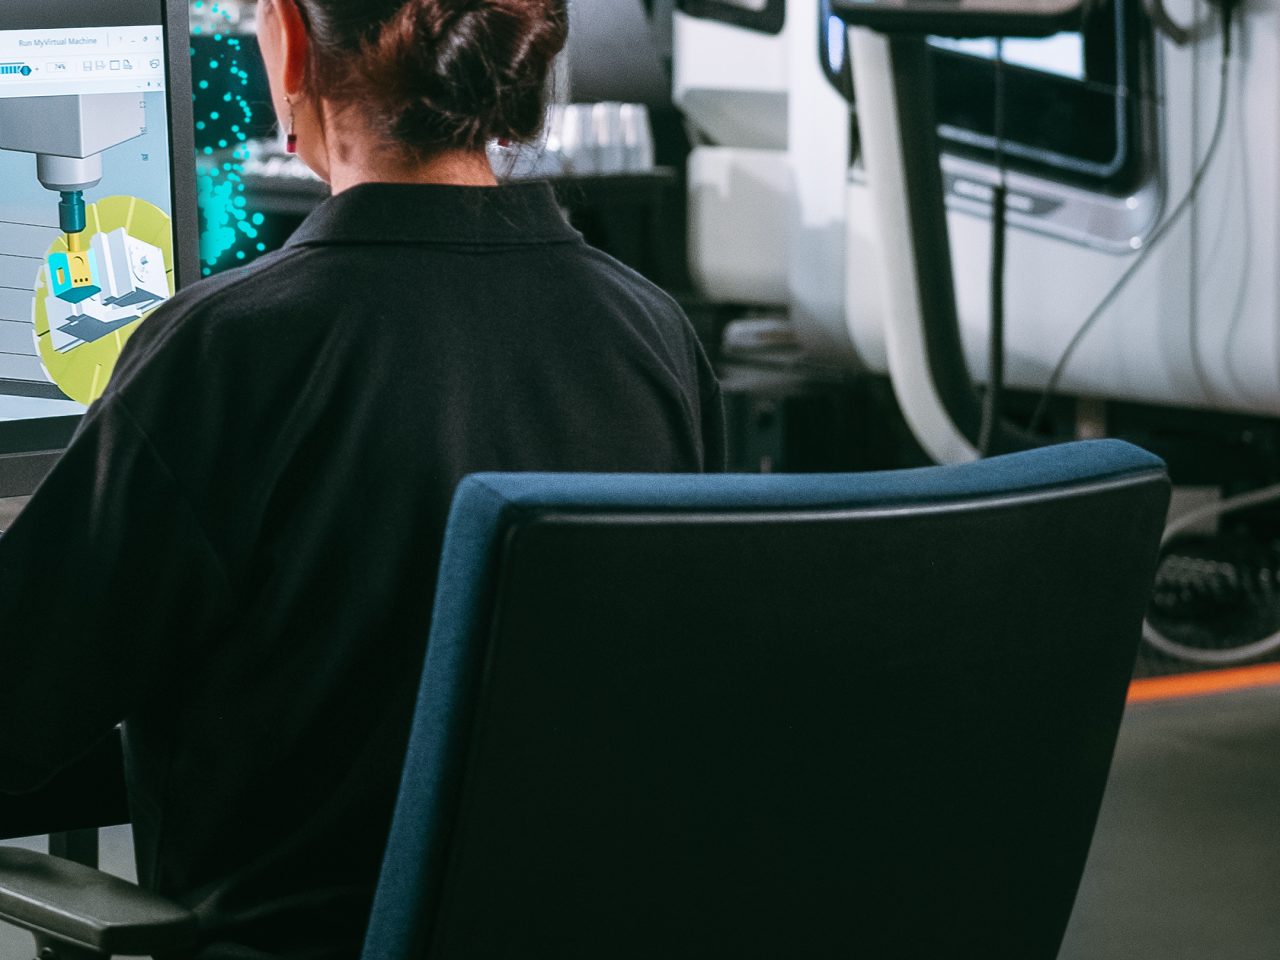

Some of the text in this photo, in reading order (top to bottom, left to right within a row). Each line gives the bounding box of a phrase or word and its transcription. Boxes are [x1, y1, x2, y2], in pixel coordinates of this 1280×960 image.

[19, 36, 97, 48] Run MyVirtual Machine
